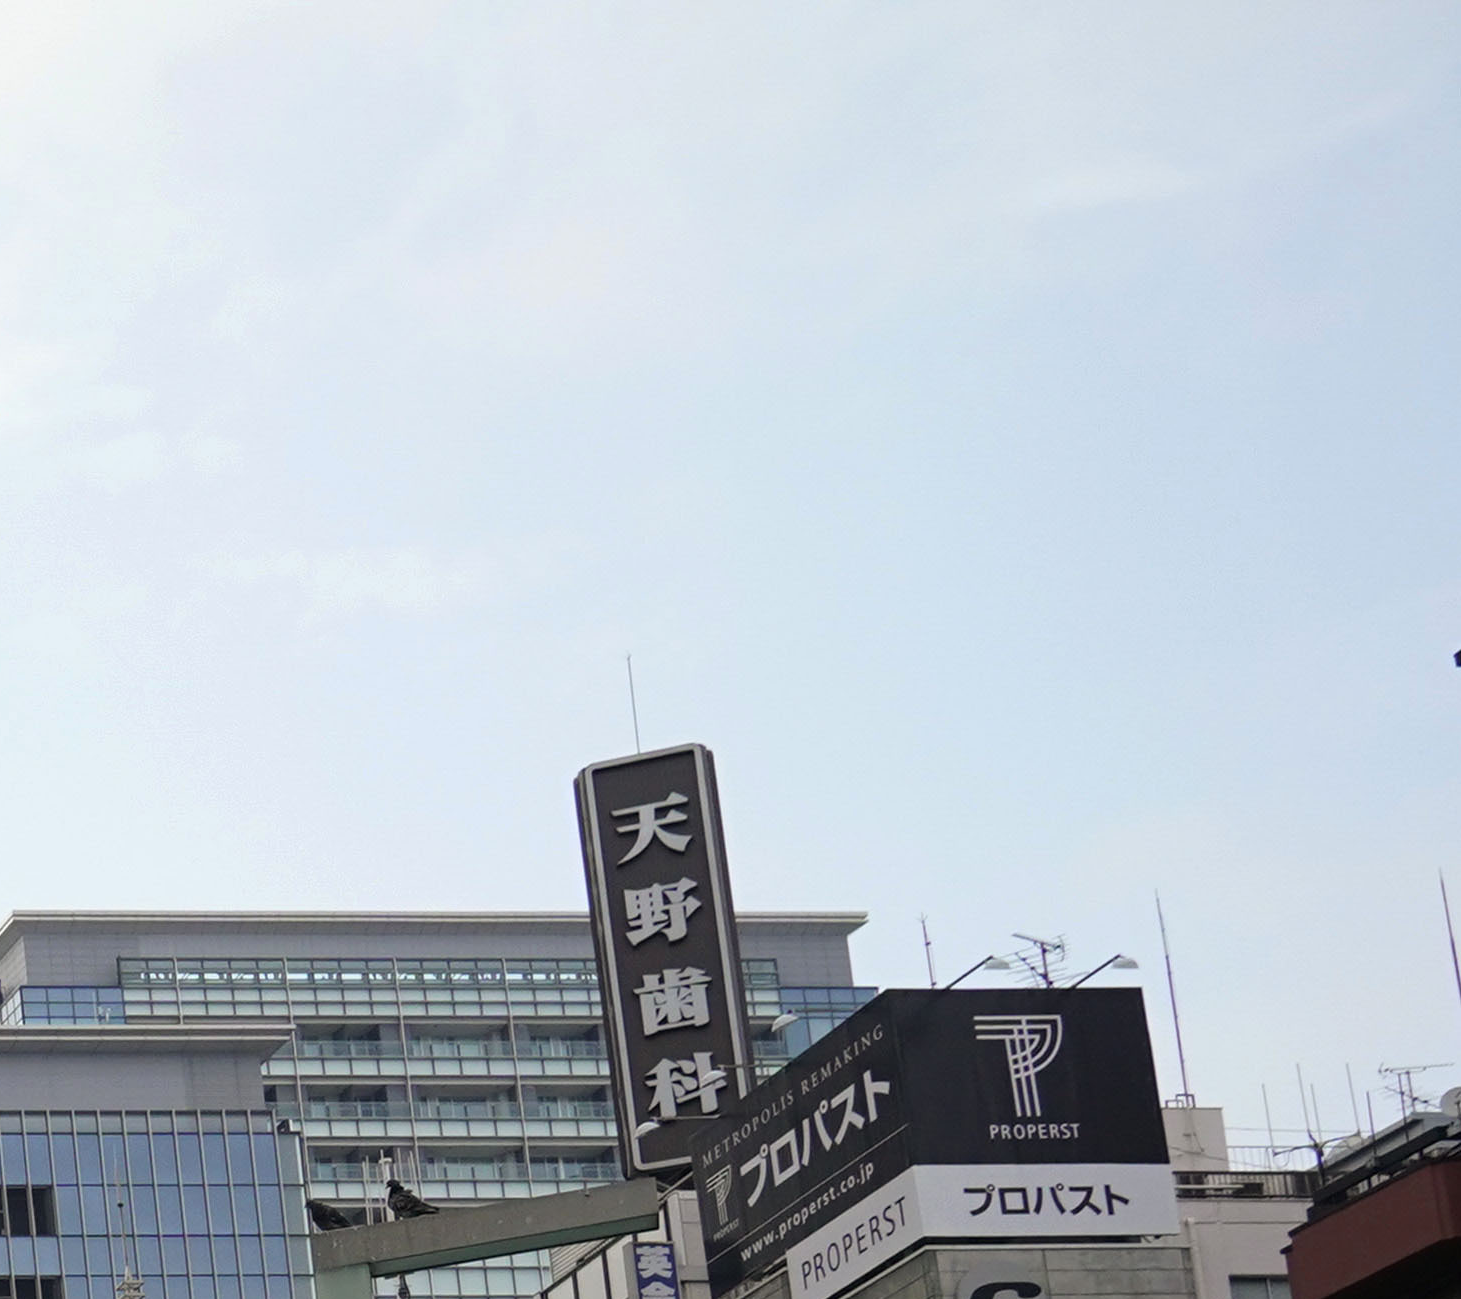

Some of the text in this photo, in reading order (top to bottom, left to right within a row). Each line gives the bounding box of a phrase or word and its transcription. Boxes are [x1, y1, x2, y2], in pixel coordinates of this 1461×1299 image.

[611, 791, 727, 1120] 天野歯科
[702, 1024, 885, 1169] METROPOLIS REMAKING
[740, 1069, 891, 1208] プロパスト
[989, 1123, 1081, 1140] PROPERST
[740, 1161, 876, 1262] www.properst.co.jp
[801, 1197, 907, 1290] PROPERST
[963, 1184, 1130, 1216] プロパスト
